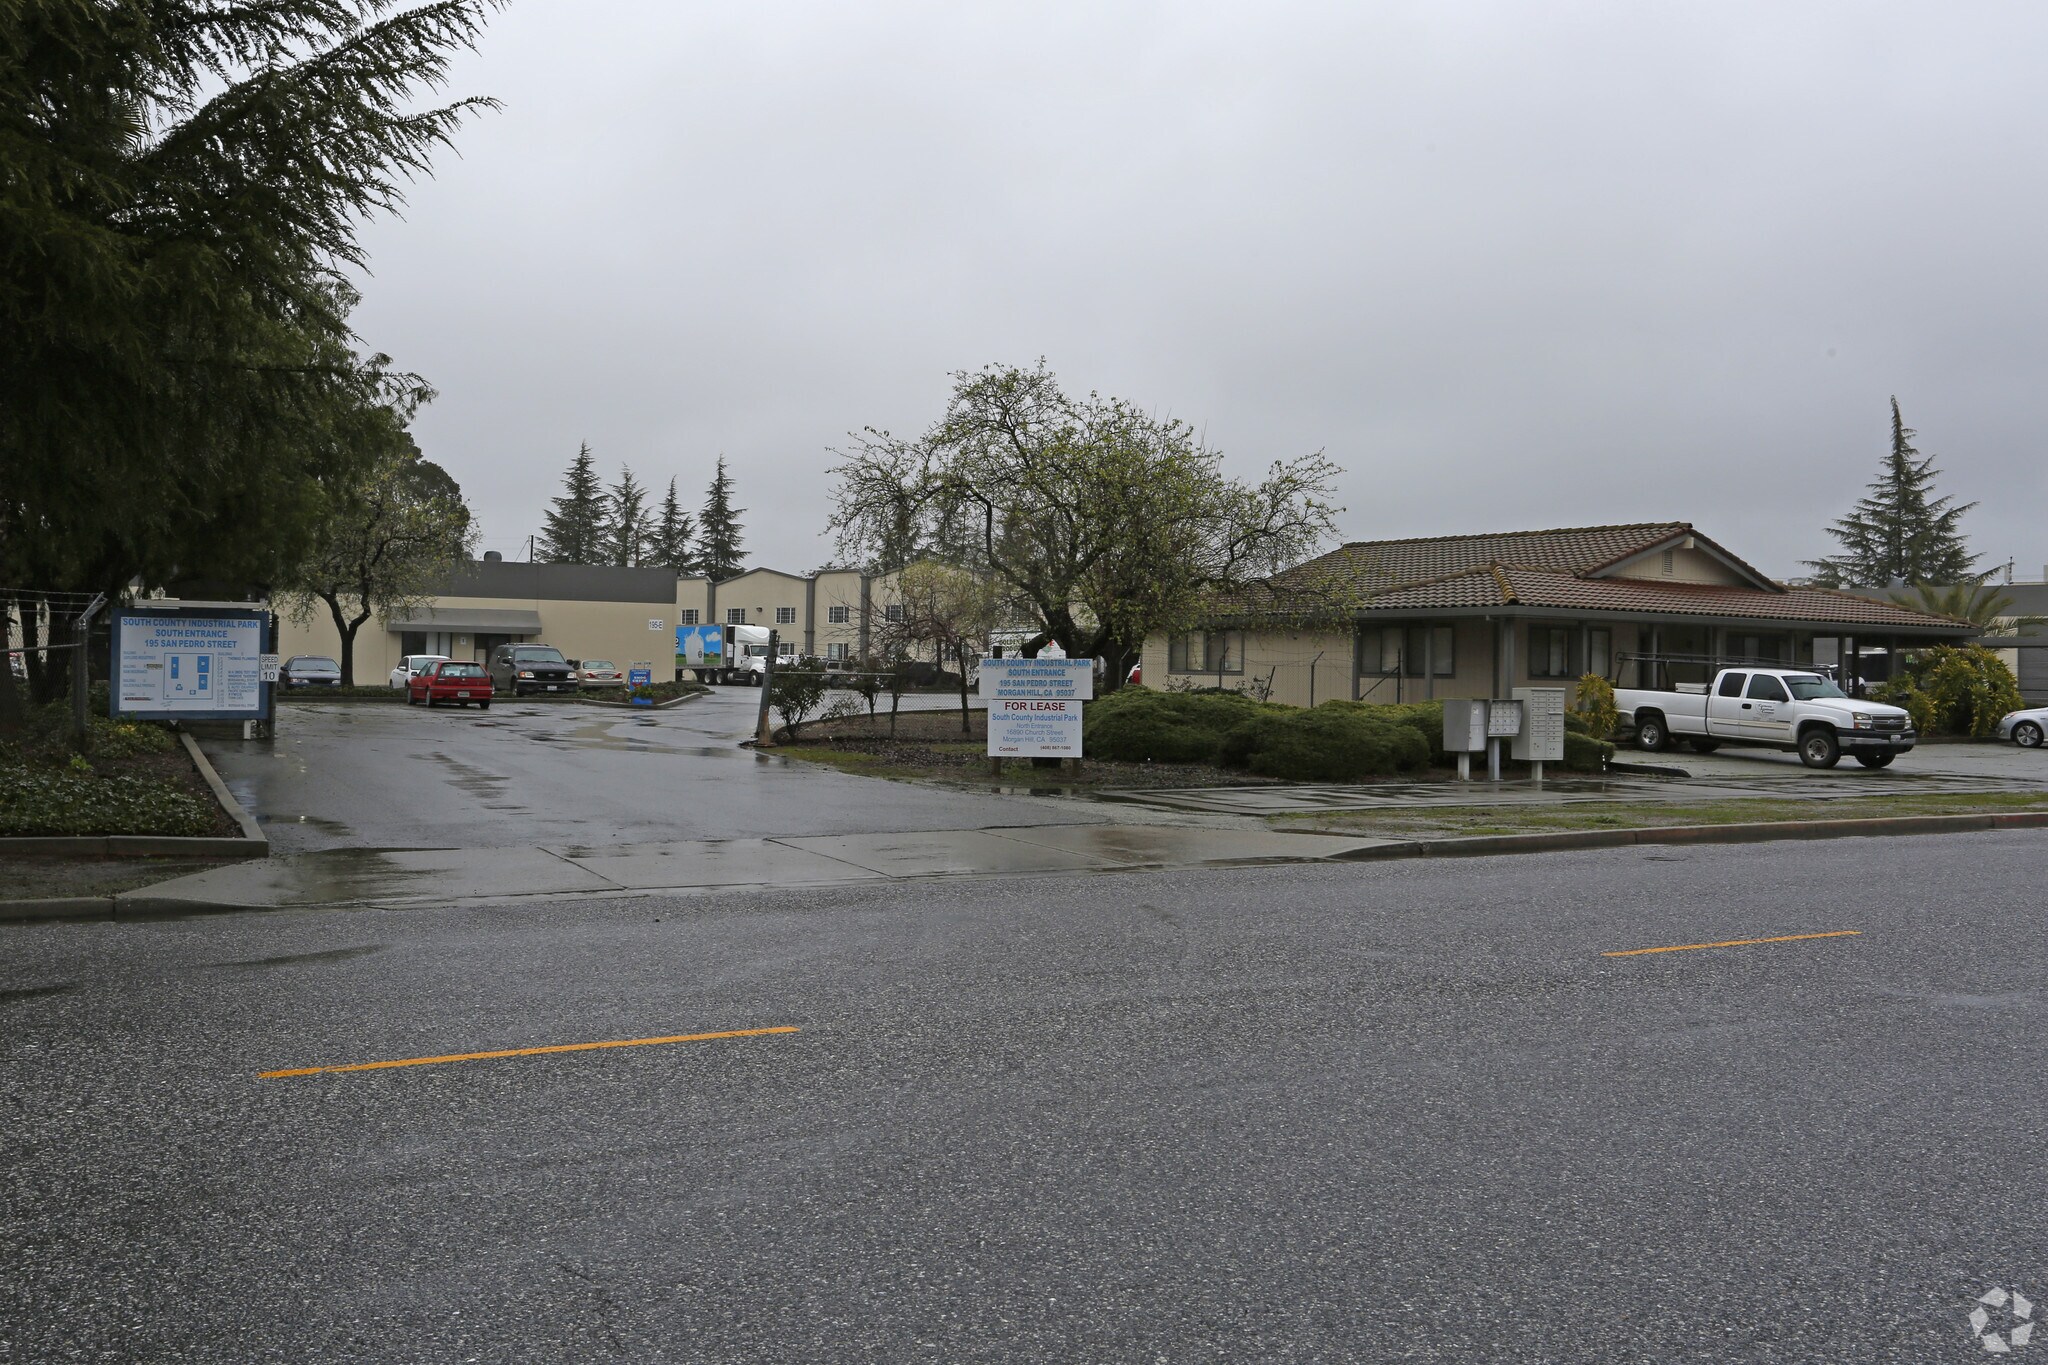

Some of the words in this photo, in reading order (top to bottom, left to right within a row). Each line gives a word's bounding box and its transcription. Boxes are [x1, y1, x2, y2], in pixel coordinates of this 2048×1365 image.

[122, 618, 150, 626] SOUTH
[153, 618, 186, 627] COUNTY
[188, 620, 236, 628] INDUSTRIAL
[264, 672, 275, 680] 10
[1005, 702, 1027, 710] FOR
[1030, 702, 1066, 711] LEASE
[1011, 713, 1033, 722] County
